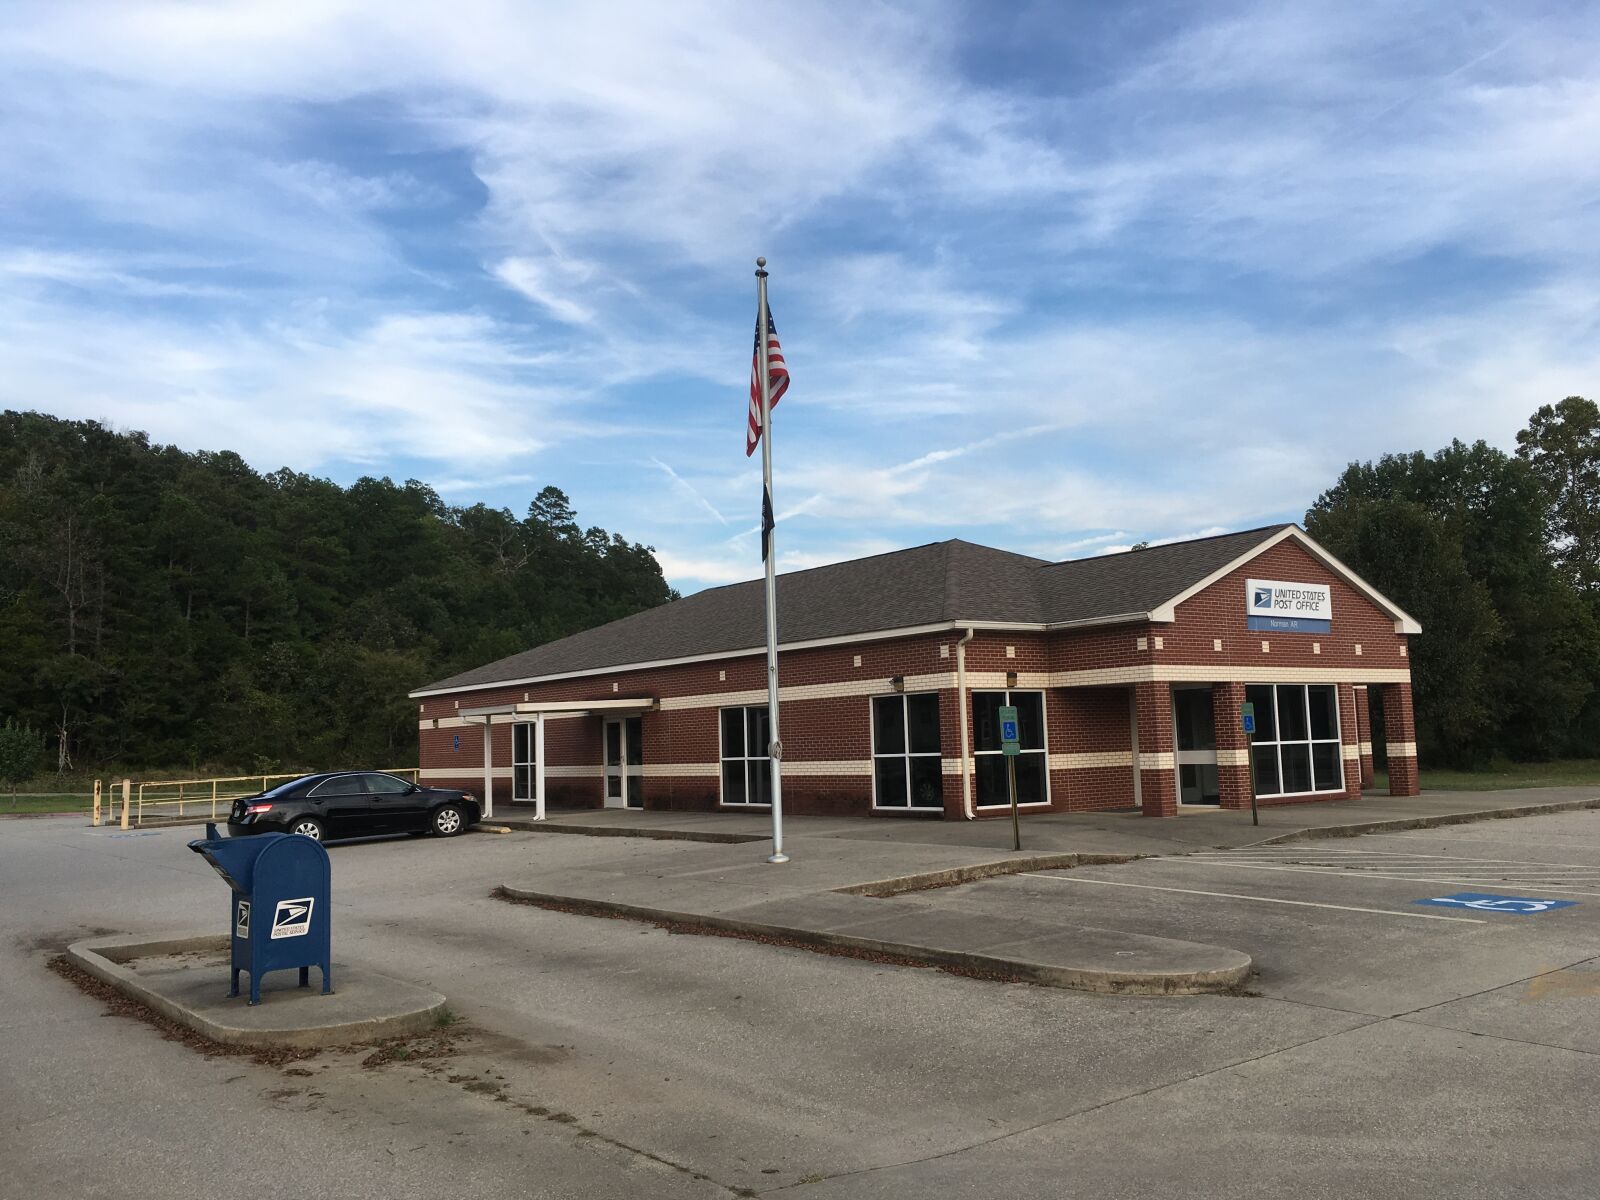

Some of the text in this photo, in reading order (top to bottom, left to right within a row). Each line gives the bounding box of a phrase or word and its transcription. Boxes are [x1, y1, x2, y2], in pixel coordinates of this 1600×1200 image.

[1274, 589, 1325, 601] UNITED STATES
[1274, 600, 1320, 611] POST OFFICE
[1271, 620, 1289, 628] Nor
